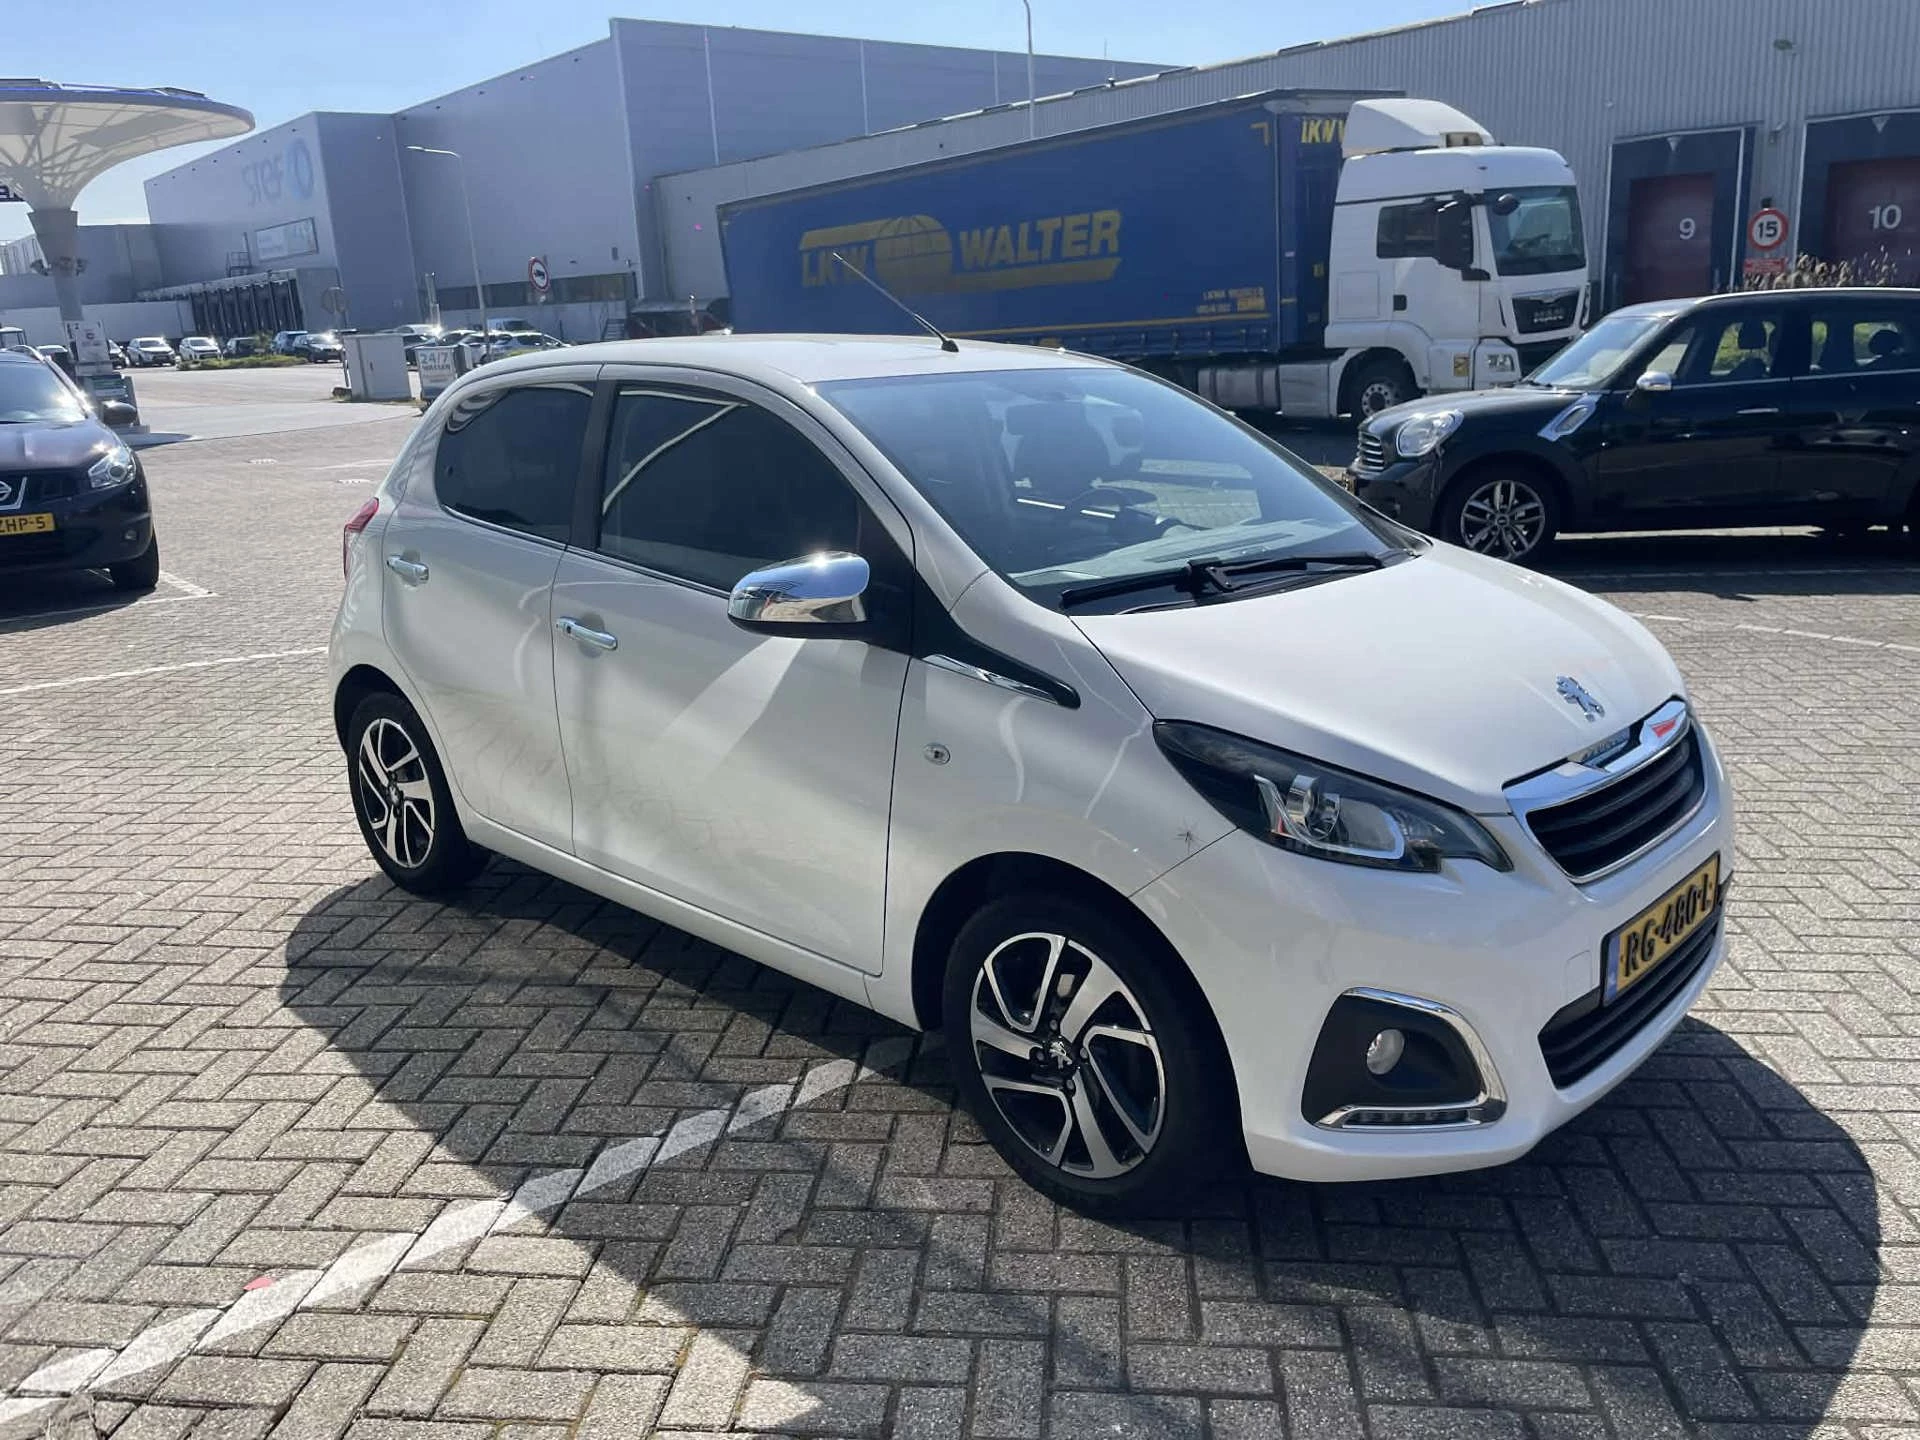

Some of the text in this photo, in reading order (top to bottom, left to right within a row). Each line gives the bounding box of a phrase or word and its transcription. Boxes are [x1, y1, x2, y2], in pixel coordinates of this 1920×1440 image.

[1679, 217, 1696, 240] 9
[1757, 220, 1778, 239] 15
[1868, 204, 1902, 230] 10
[959, 208, 1121, 271] WALTER
[1624, 873, 1711, 977] RG-480-L
